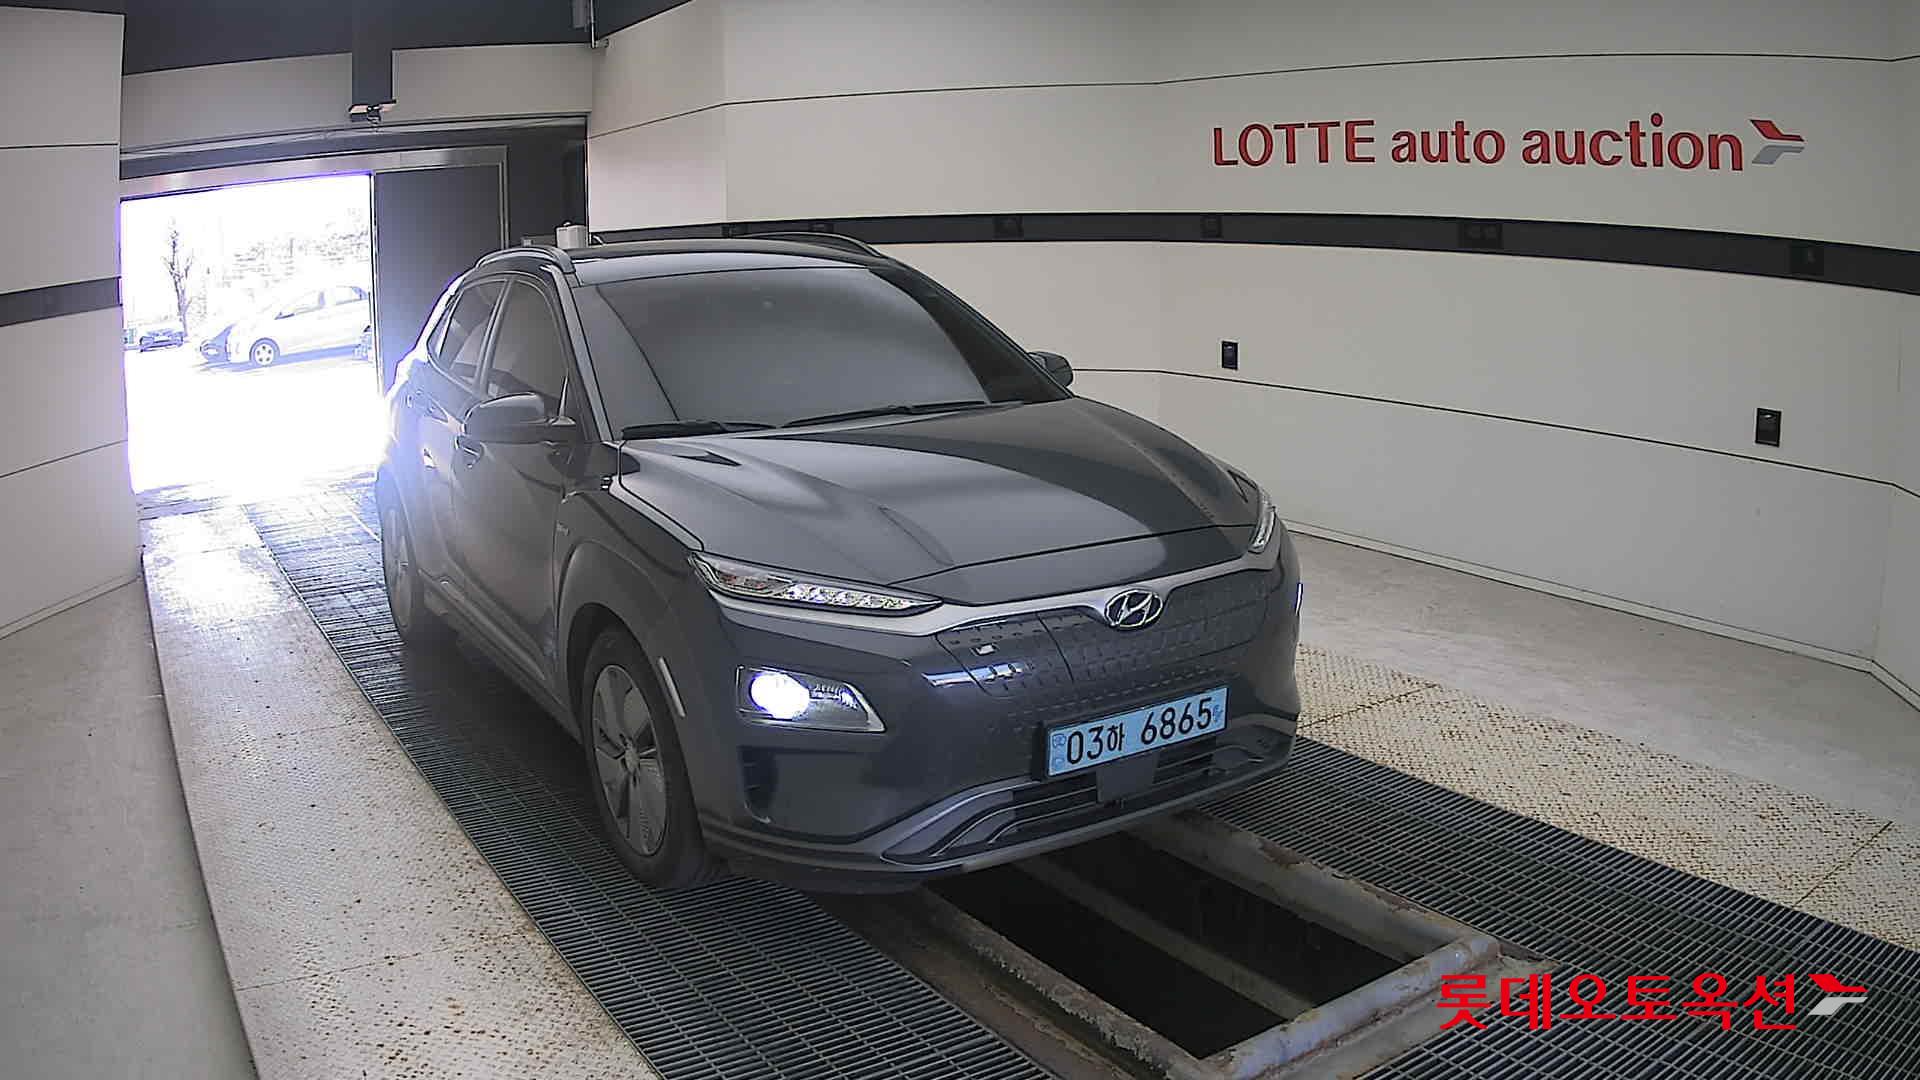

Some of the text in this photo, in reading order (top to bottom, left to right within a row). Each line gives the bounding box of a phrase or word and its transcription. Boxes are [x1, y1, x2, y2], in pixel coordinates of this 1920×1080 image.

[1212, 113, 1744, 171] LOTTE auto auction
[1067, 722, 1125, 765] 03하
[1141, 697, 1212, 745] 6865
